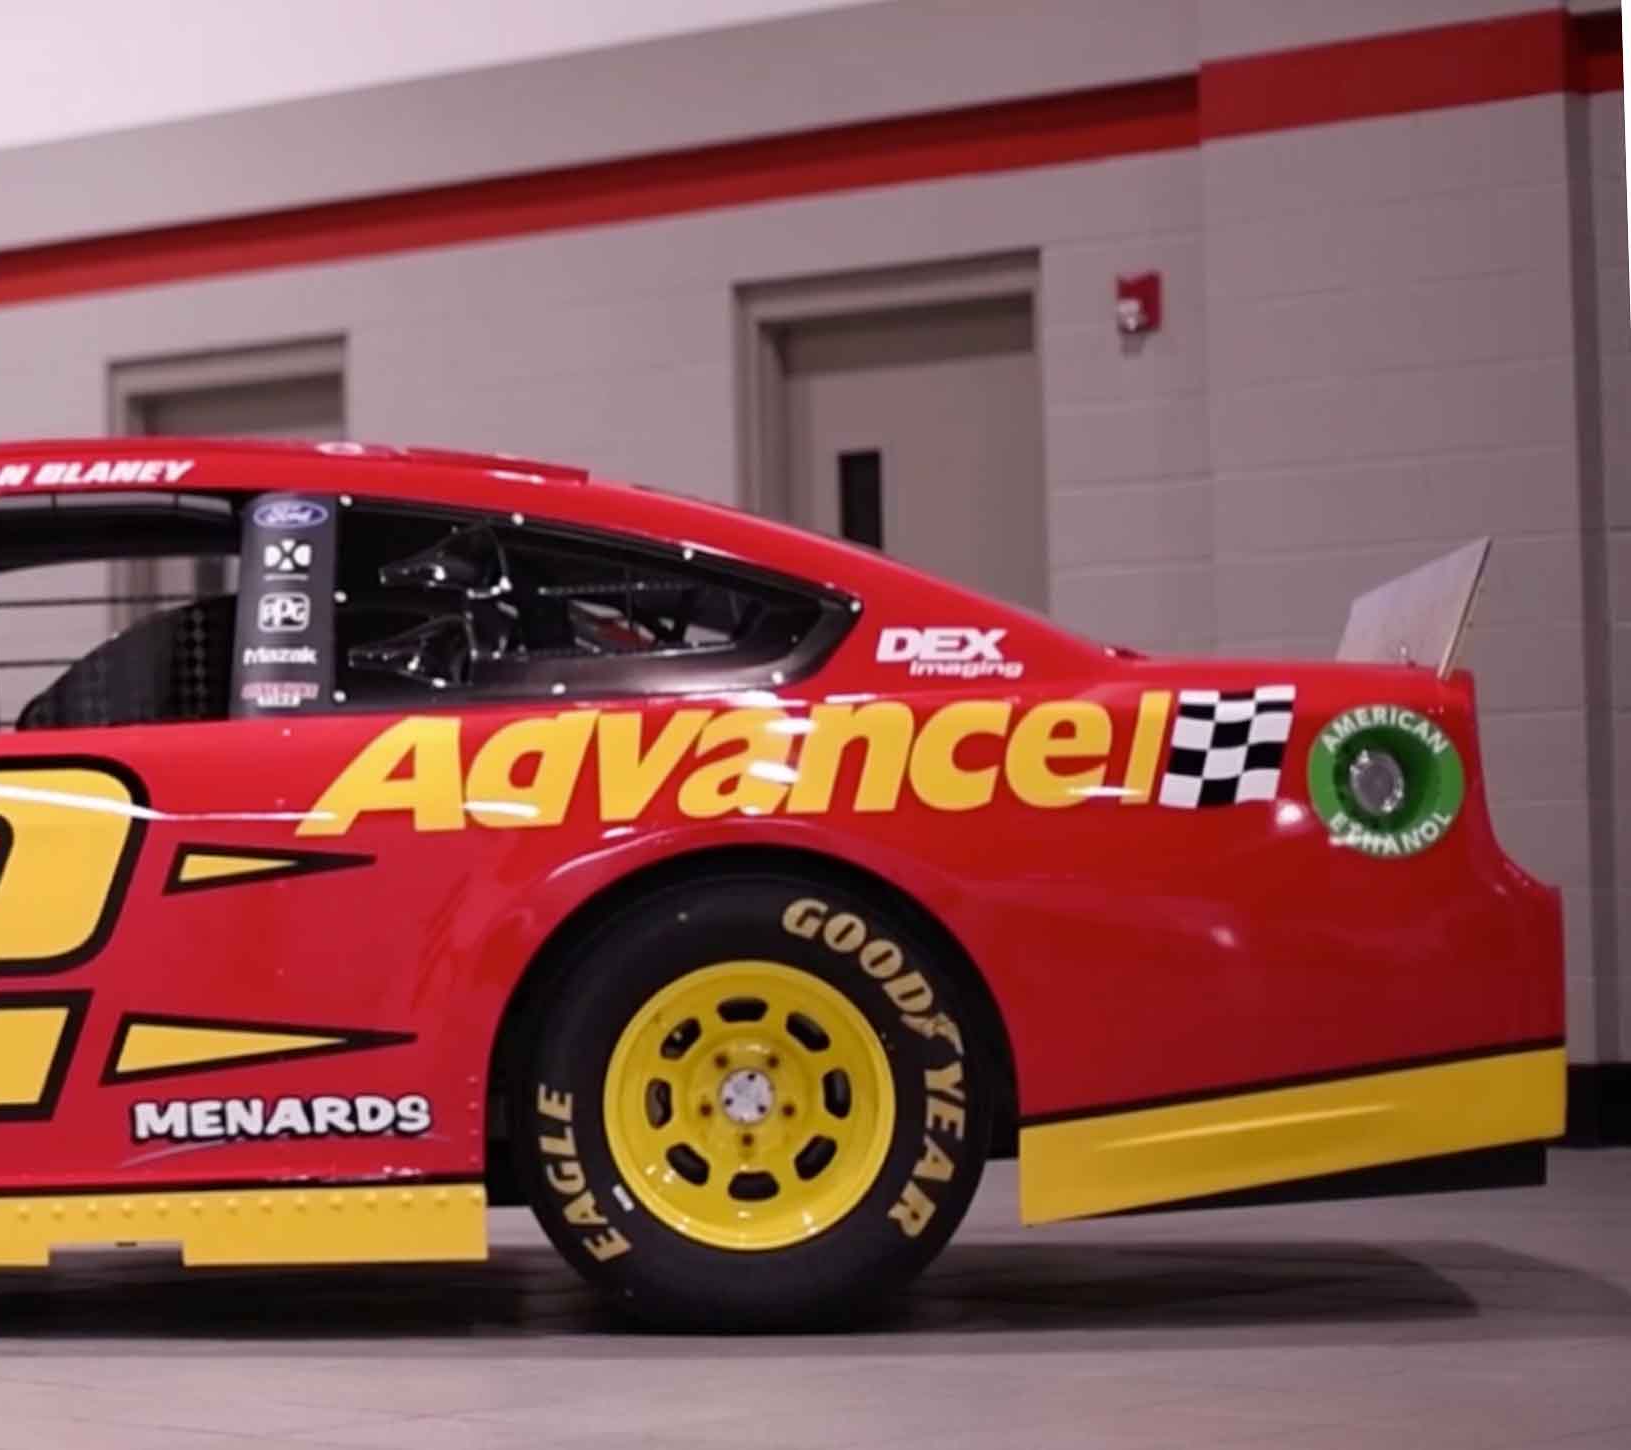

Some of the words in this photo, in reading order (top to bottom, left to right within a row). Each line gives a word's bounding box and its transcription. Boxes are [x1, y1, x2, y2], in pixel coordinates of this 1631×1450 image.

[33, 459, 195, 486] BLANEY
[259, 598, 308, 626] PPG
[243, 646, 317, 666] Mazak
[876, 626, 1007, 663] DEX
[1321, 703, 1450, 755] AMERICAN
[1329, 810, 1452, 856] ETHANOL
[131, 1093, 433, 1140] MENARDS
[536, 1083, 632, 1263] EAGLE
